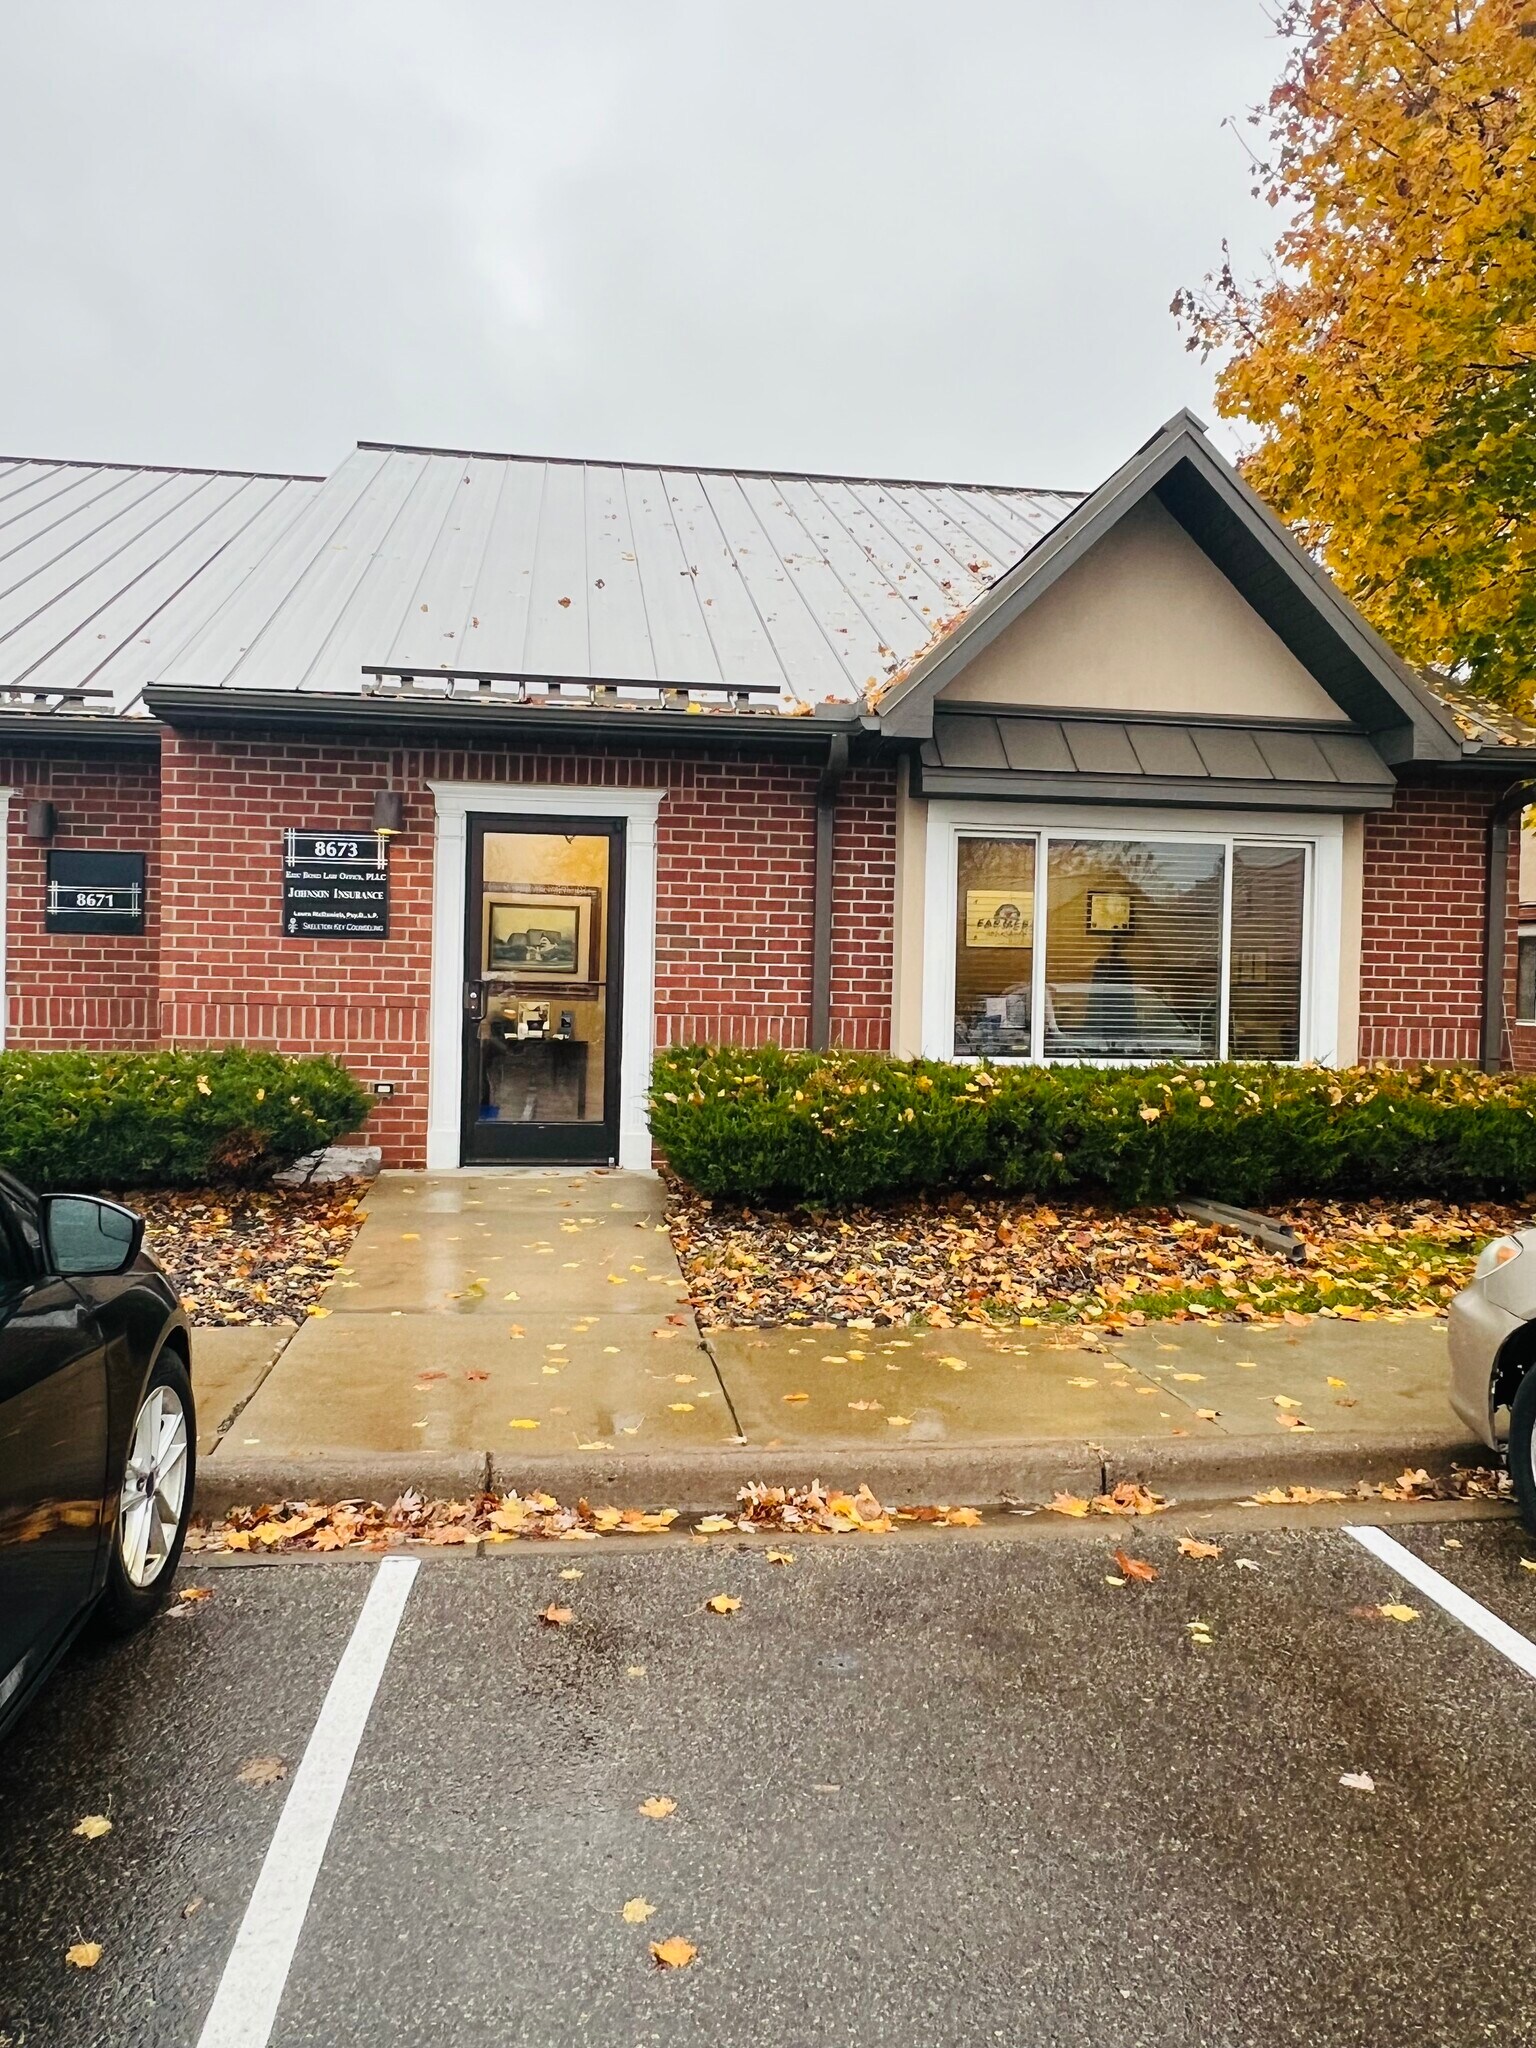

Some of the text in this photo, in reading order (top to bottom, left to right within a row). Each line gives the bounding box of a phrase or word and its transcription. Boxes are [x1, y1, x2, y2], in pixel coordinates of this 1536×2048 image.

[314, 841, 358, 857] 8673
[76, 893, 114, 907] 8671
[288, 887, 384, 900] JOHNSON INSURANCE
